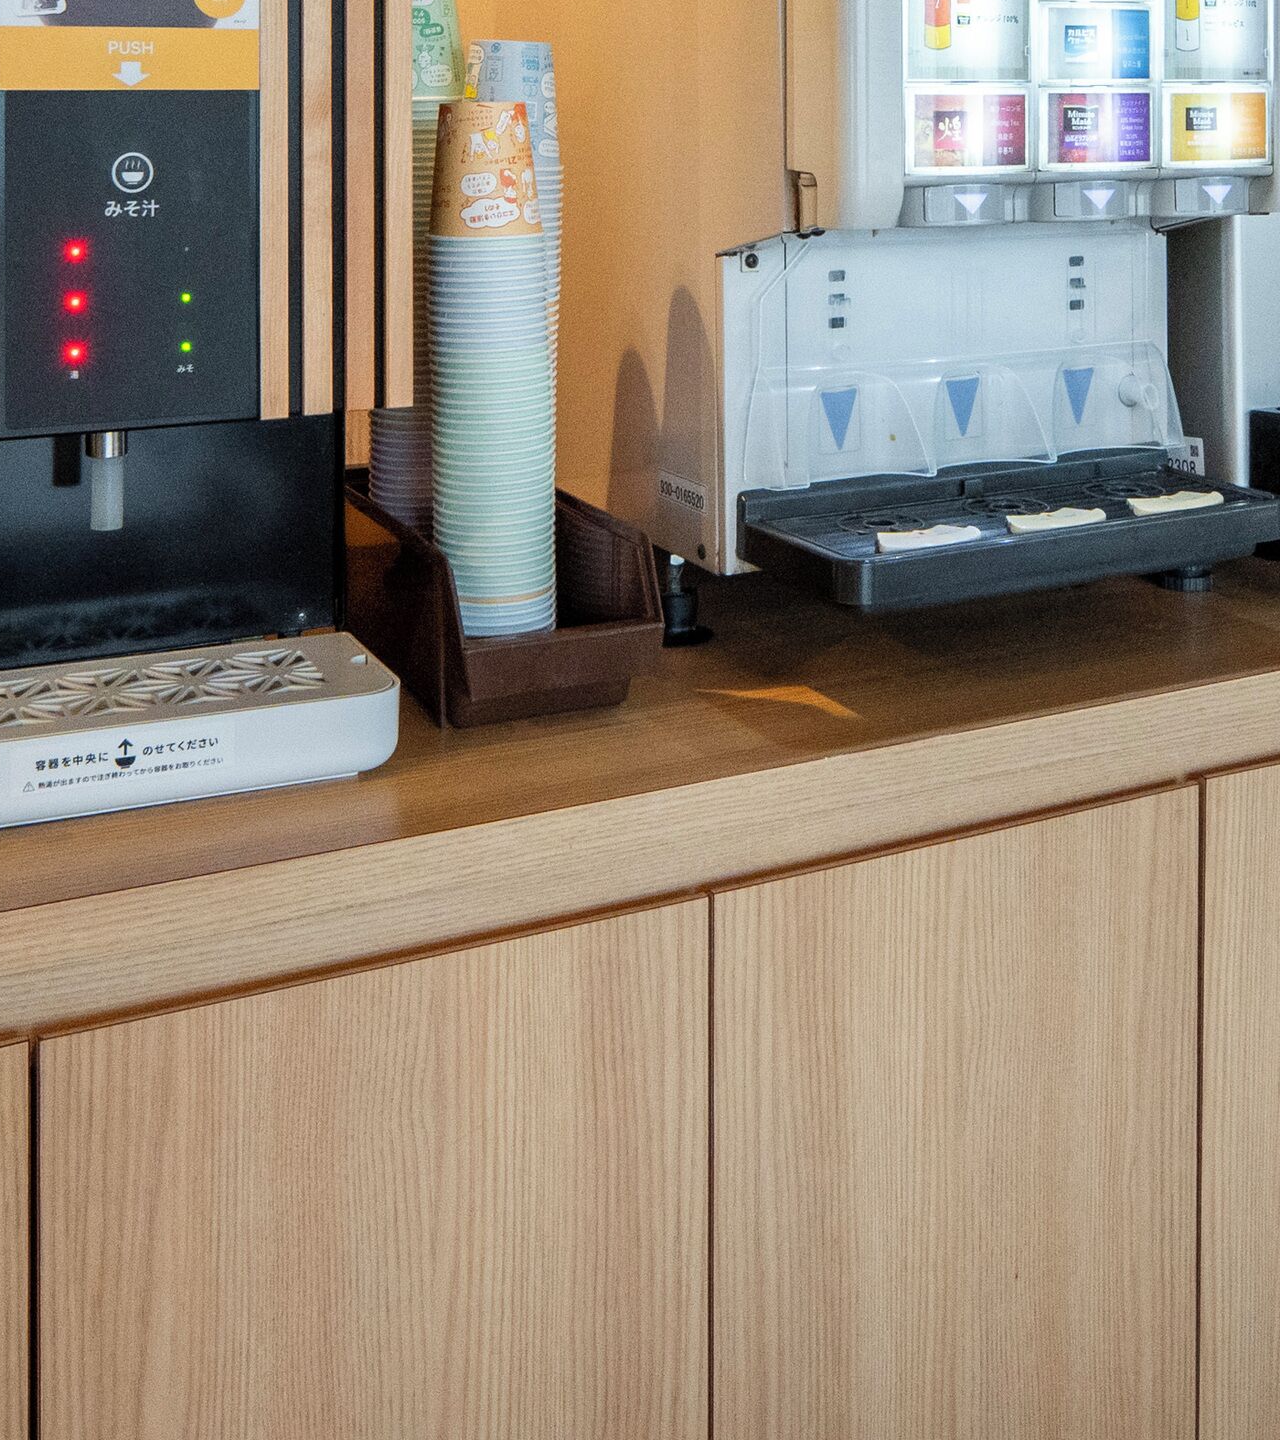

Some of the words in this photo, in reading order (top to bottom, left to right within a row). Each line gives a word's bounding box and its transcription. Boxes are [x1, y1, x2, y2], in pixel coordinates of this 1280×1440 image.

[107, 40, 154, 55] PUSH
[937, 116, 963, 143] 煌
[104, 199, 160, 217] みそ汁
[34, 751, 109, 772] 容器を中央に
[142, 736, 219, 756] のせてください
